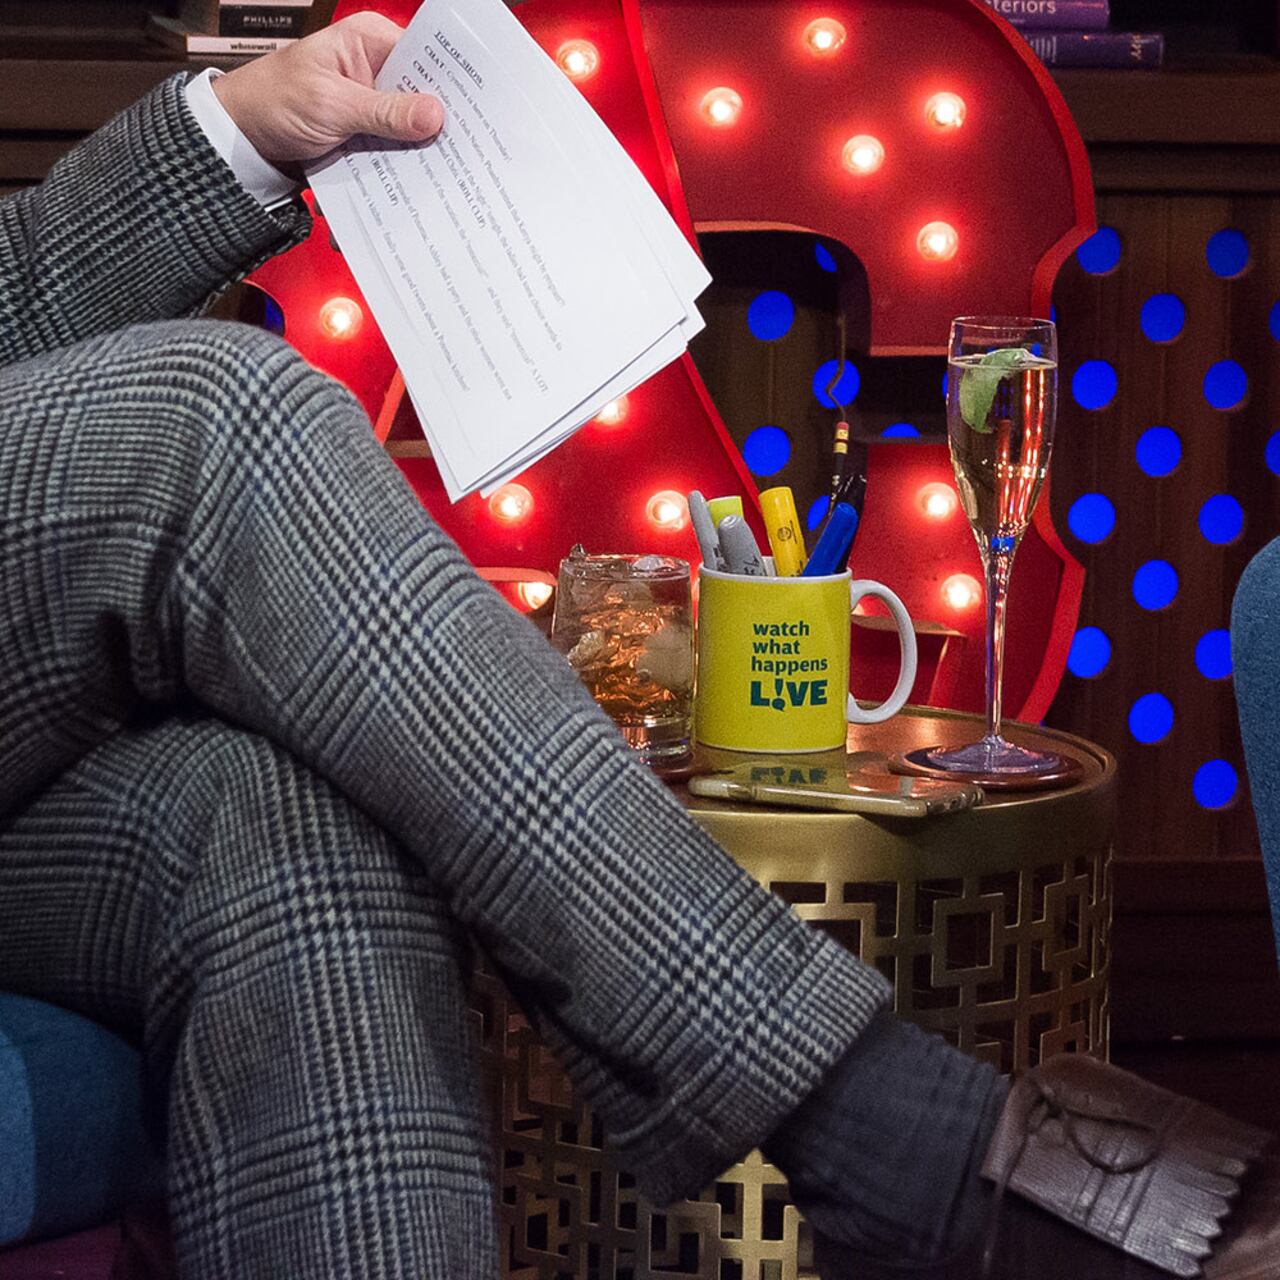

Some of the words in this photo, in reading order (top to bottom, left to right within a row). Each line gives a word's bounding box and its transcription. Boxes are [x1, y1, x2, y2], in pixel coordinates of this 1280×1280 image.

[433, 30, 452, 49] TOP
[444, 69, 470, 98] Cynthia
[369, 156, 389, 184] (ROLL
[382, 182, 401, 207] CLIP)
[469, 203, 488, 229] CLIP)
[753, 621, 810, 637] watch
[753, 639, 801, 655] what
[751, 656, 828, 676] happens
